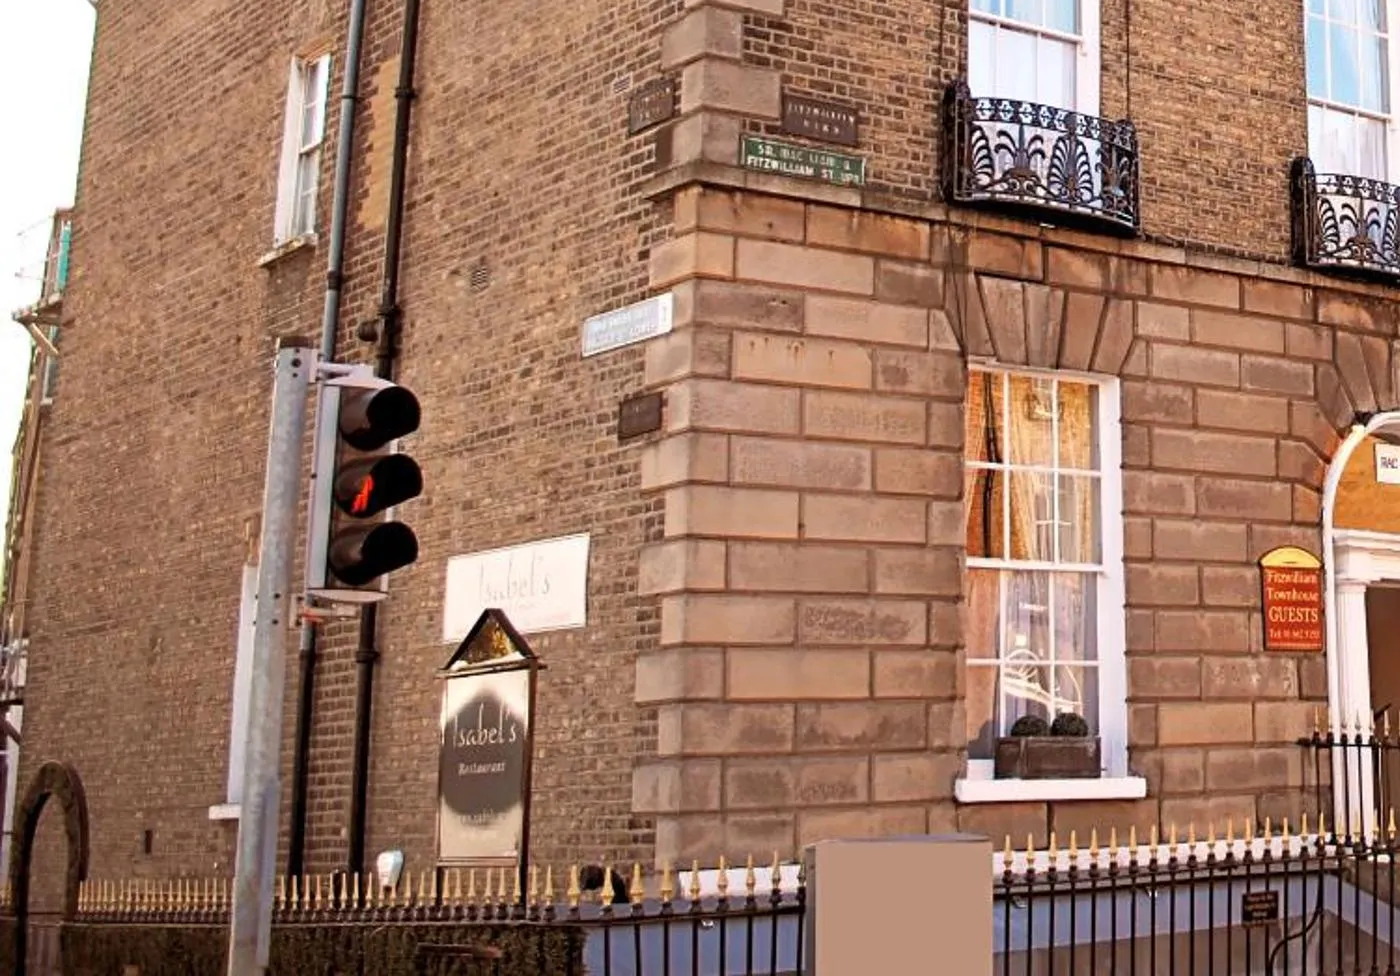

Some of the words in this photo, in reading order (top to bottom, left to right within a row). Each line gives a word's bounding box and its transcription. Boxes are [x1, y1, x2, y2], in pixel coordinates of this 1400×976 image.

[746, 154, 815, 176] FITZWILLIAM
[1267, 587, 1319, 602] Townhouse
[1268, 606, 1318, 623] GUESTS
[453, 701, 517, 748] Isabel's
[458, 762, 506, 776] Restaurant
